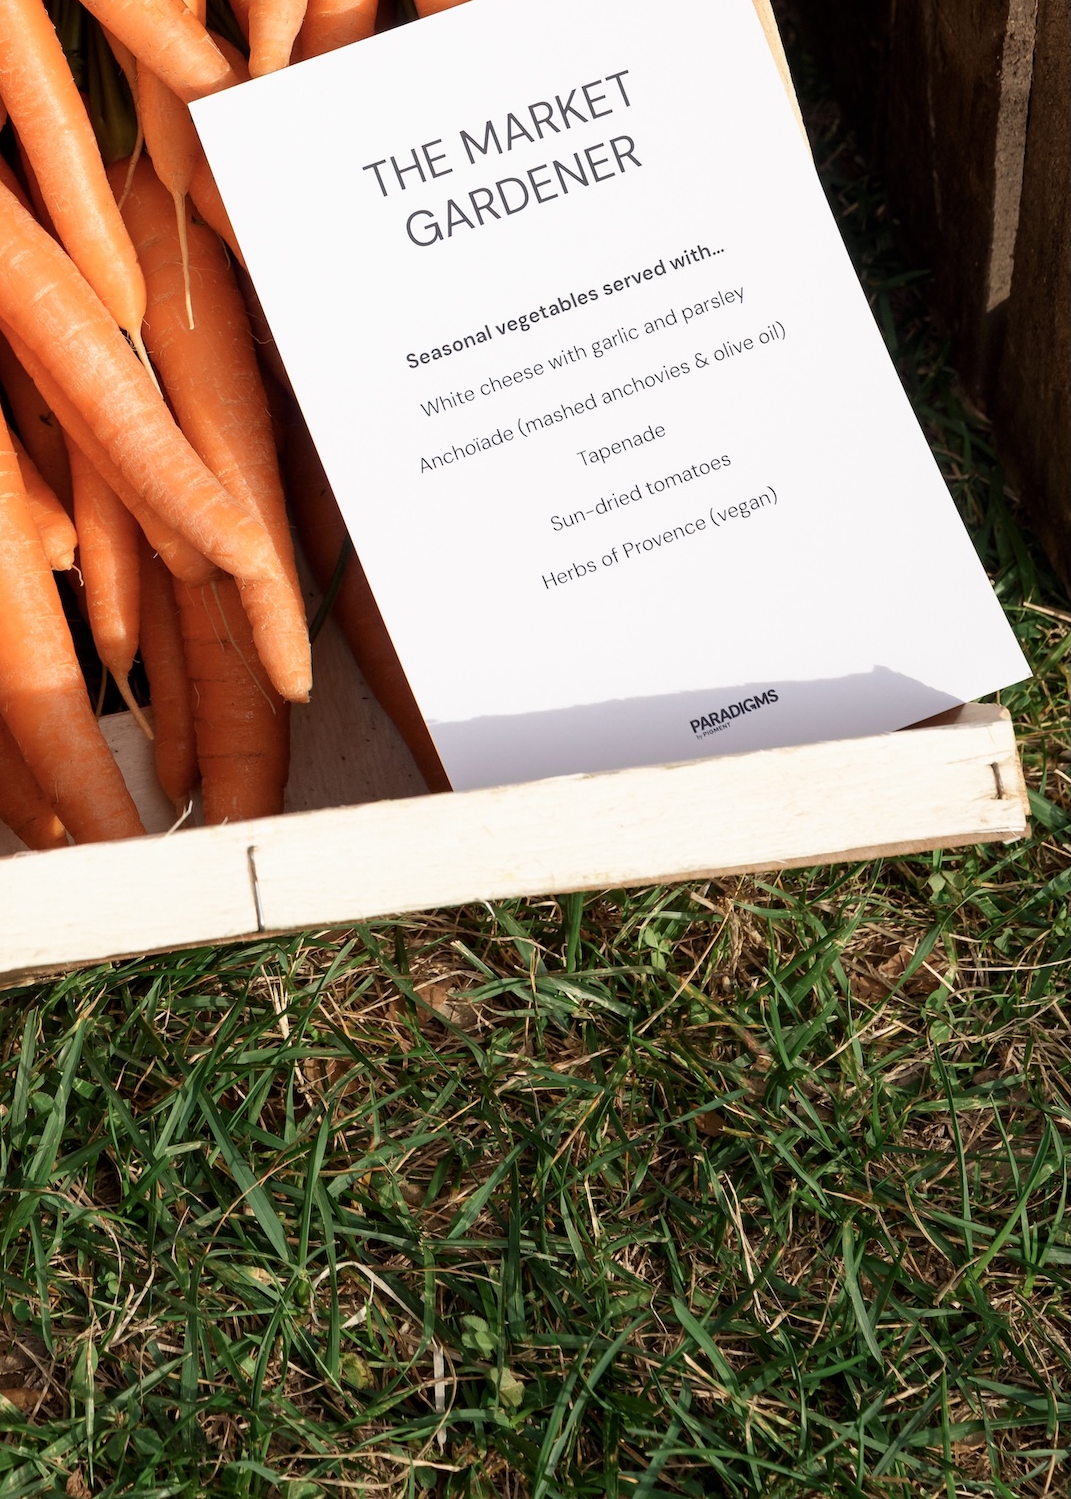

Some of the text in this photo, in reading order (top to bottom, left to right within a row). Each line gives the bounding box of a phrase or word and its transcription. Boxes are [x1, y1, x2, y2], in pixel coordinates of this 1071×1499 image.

[362, 70, 630, 197] THE MARKET
[406, 134, 642, 247] GARDENER
[406, 324, 493, 368] Seasonal
[495, 288, 599, 336] vegetables
[603, 259, 666, 295] served
[420, 286, 744, 417] White cheese with garlic and parsley
[421, 321, 785, 474] Anchoïade (mashed anchovies & olive oil)
[577, 424, 665, 466] Tapenade
[541, 485, 777, 589] Herbs of Provence (vegan)
[550, 454, 732, 531] Sun-dried tomatoes
[690, 689, 778, 733] PARADIGMS
[703, 722, 731, 737] PIGMENT
